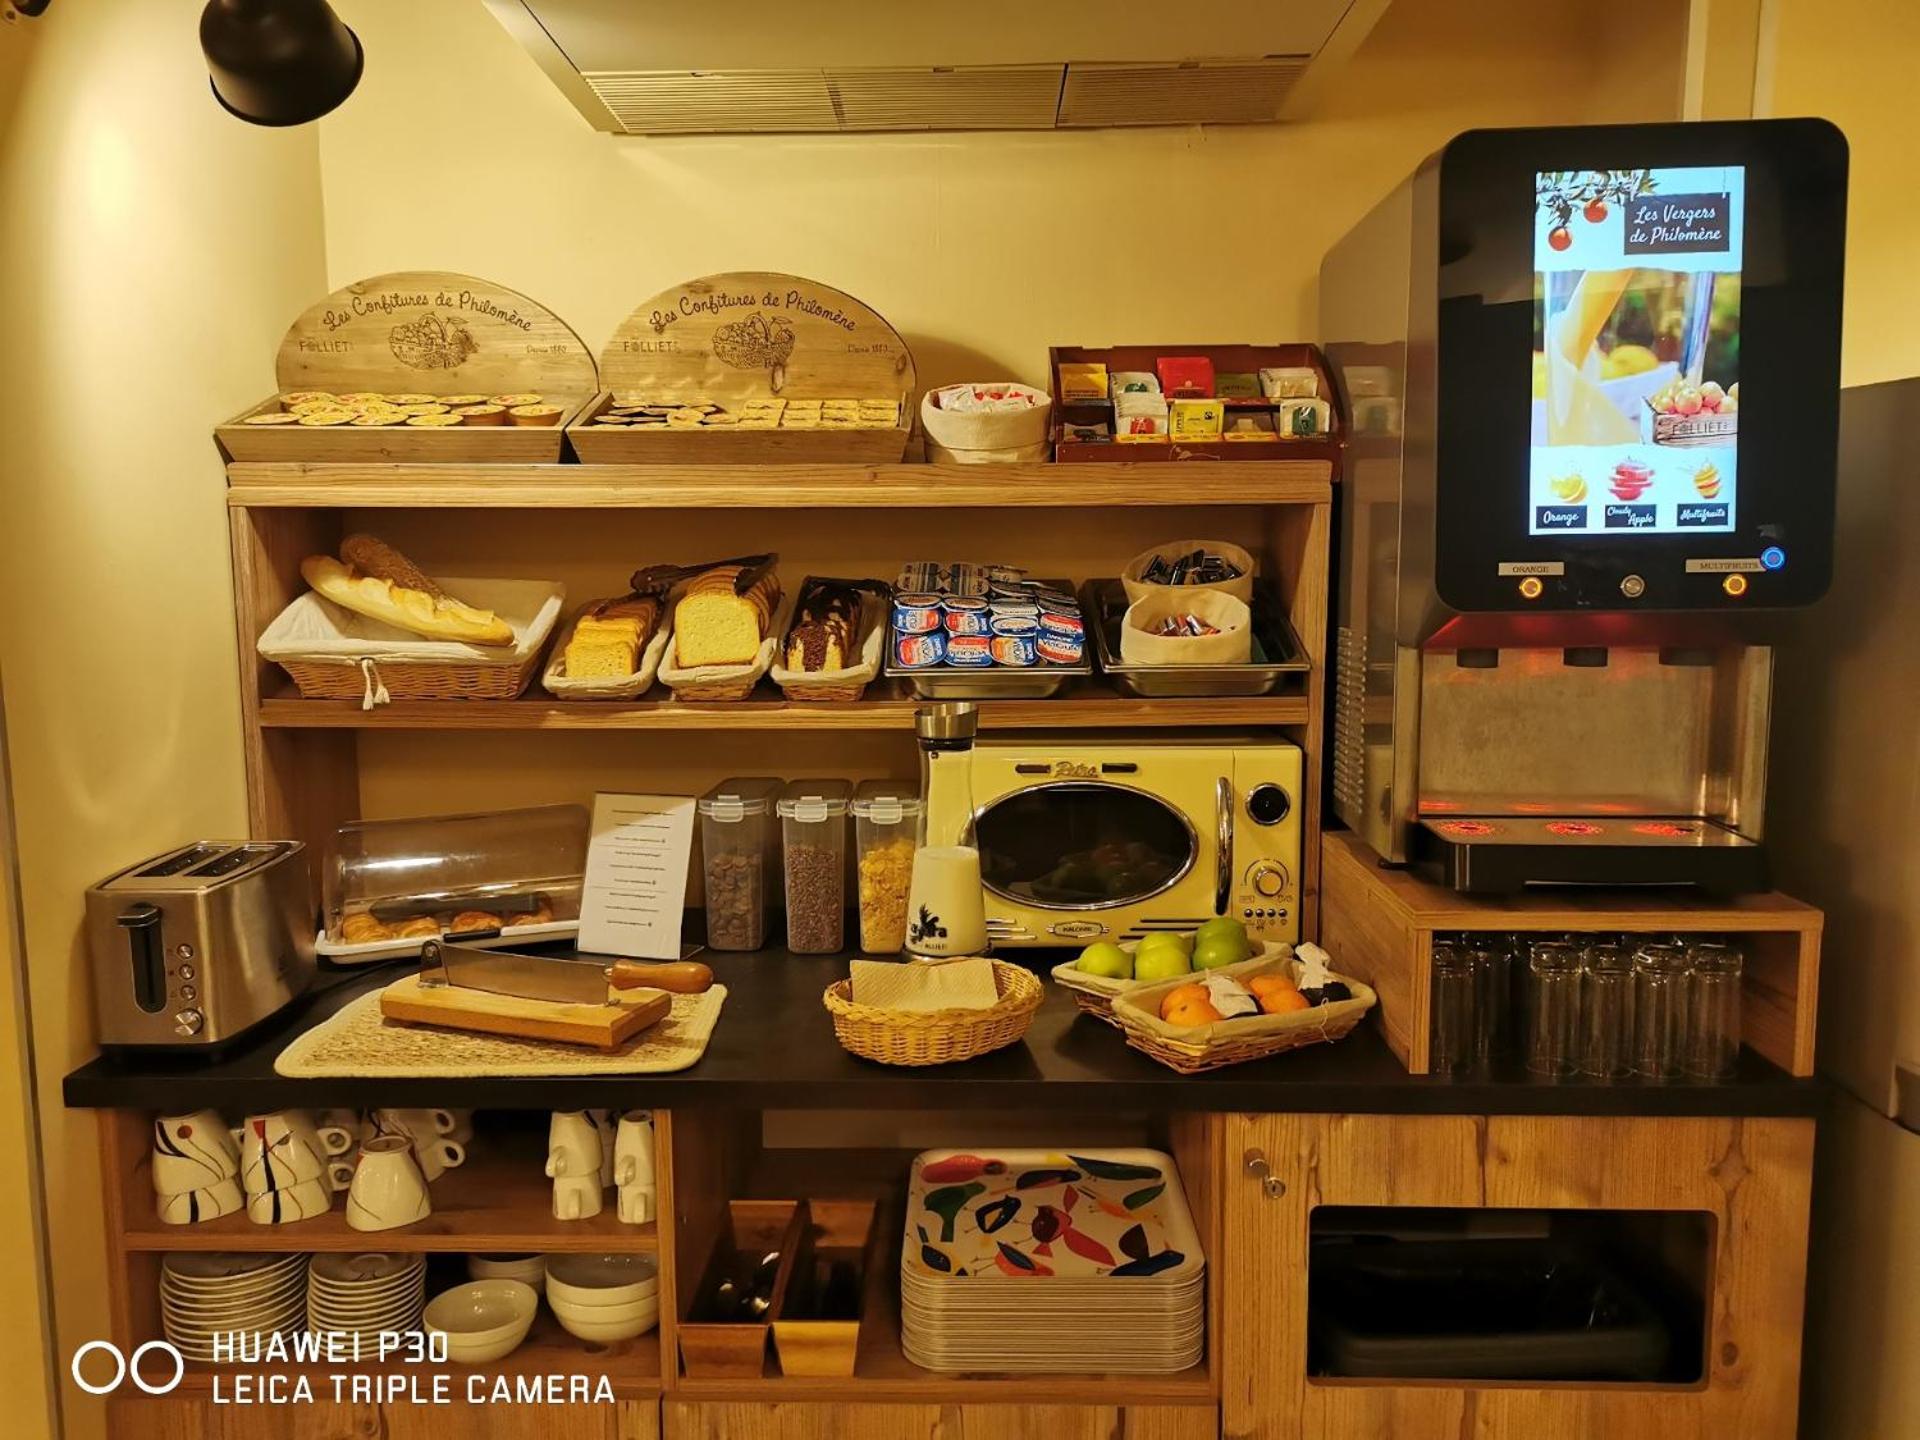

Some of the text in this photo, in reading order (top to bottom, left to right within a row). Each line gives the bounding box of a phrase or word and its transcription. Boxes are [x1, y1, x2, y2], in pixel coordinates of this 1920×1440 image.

[1634, 204, 1717, 226] Les Vergers
[1630, 227, 1722, 245] de Philomène
[323, 290, 532, 332] Les Confitures de Philomène
[649, 290, 856, 334] Les Confitures de Philomène
[1543, 510, 1580, 527] Orange
[1607, 506, 1632, 518] Cloudy
[1627, 513, 1654, 527] Apple
